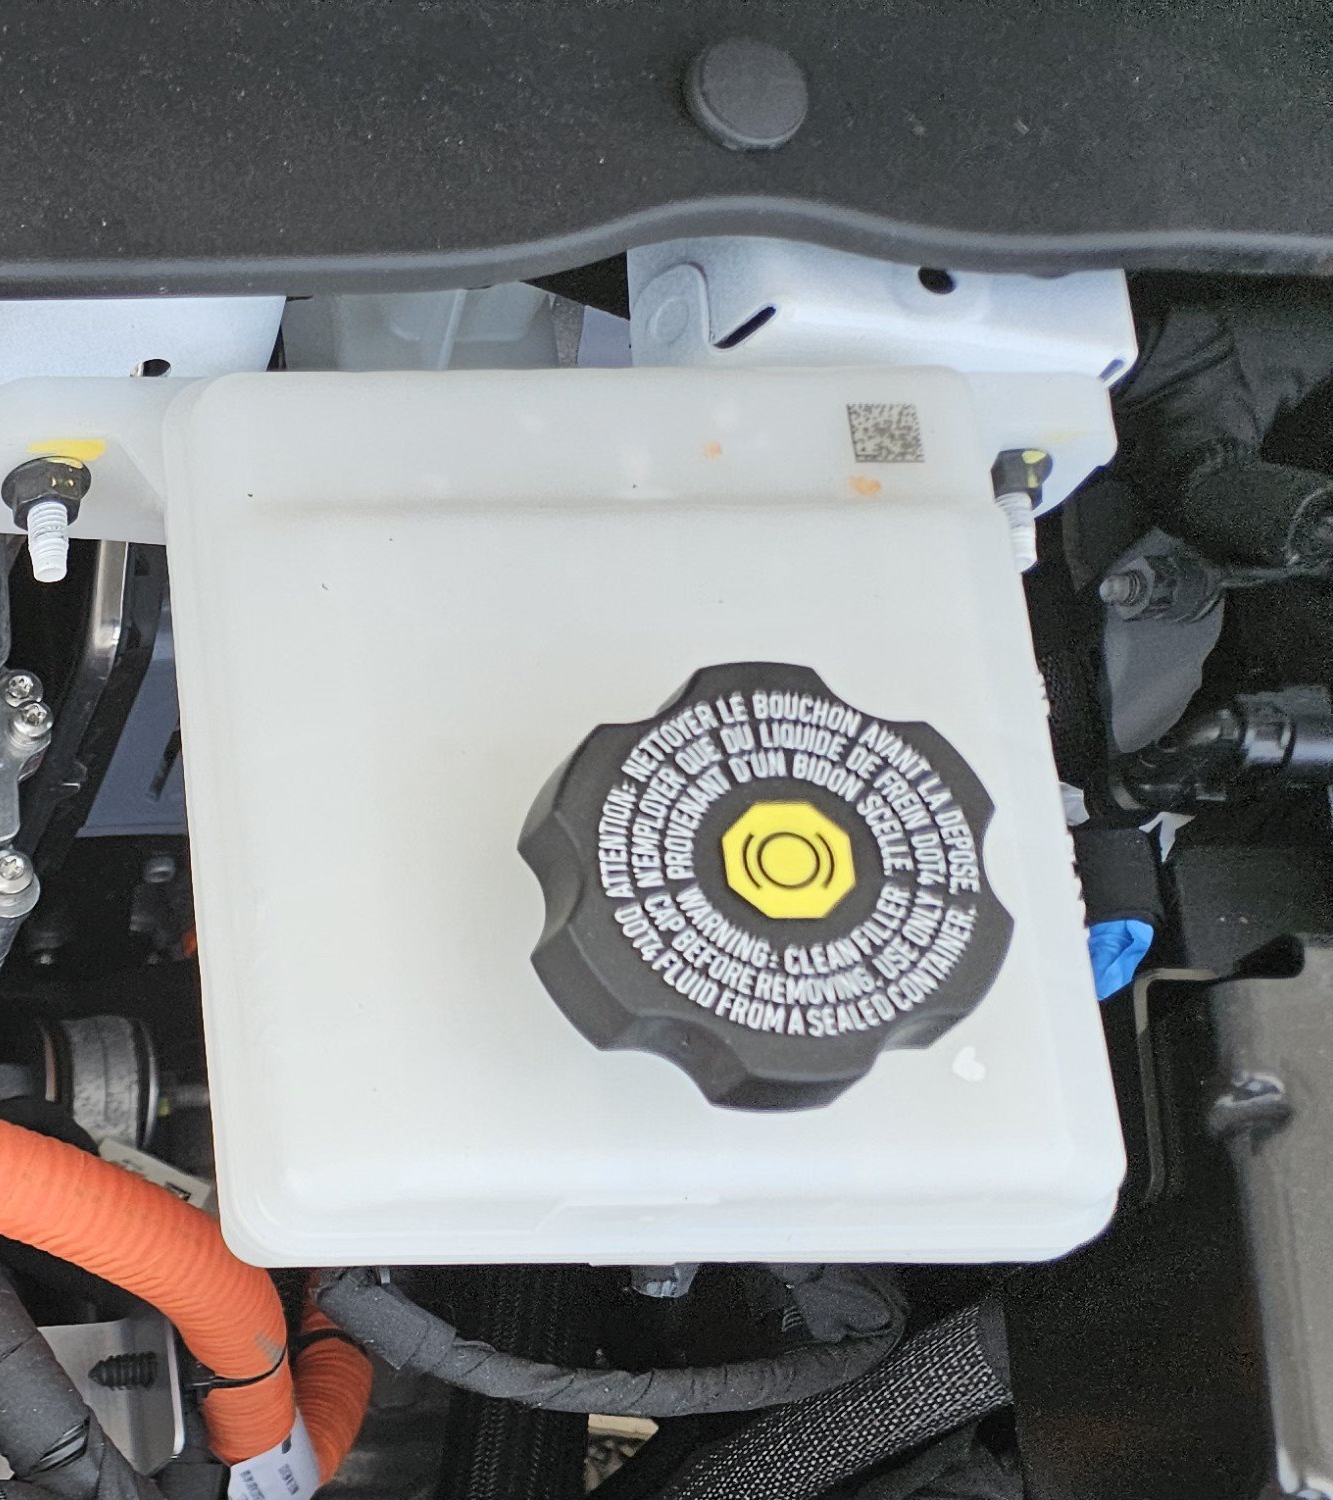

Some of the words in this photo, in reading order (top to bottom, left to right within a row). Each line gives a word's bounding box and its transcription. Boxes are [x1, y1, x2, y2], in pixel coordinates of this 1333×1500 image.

[599, 780, 638, 897] ATTENTION:
[621, 702, 720, 783] NETTOYER
[716, 691, 749, 724] LE
[753, 690, 861, 738] BOUCHON
[859, 723, 931, 781] AVANT
[917, 771, 952, 811] LA
[664, 764, 731, 880] PROVENANT
[729, 751, 786, 783] D'UN
[792, 753, 864, 802] BIDON
[675, 735, 723, 775] QUE
[720, 723, 755, 754] DU
[759, 722, 849, 764] LIQUIDE
[845, 746, 883, 779] DE
[873, 767, 931, 830] FREIN
[911, 832, 947, 885] DOT4
[614, 902, 664, 961] DOT4
[652, 949, 719, 1008] FLUID
[715, 988, 786, 1034] FROM
[787, 1005, 806, 1036] A
[806, 994, 896, 1037] SEALED
[644, 892, 686, 932] CAP
[672, 926, 756, 995] BEFORE
[872, 935, 920, 980] USE
[901, 890, 944, 947] ONLY
[676, 884, 779, 969] WARNING:
[784, 938, 863, 975] CLEAN
[850, 883, 911, 956] FILLER
